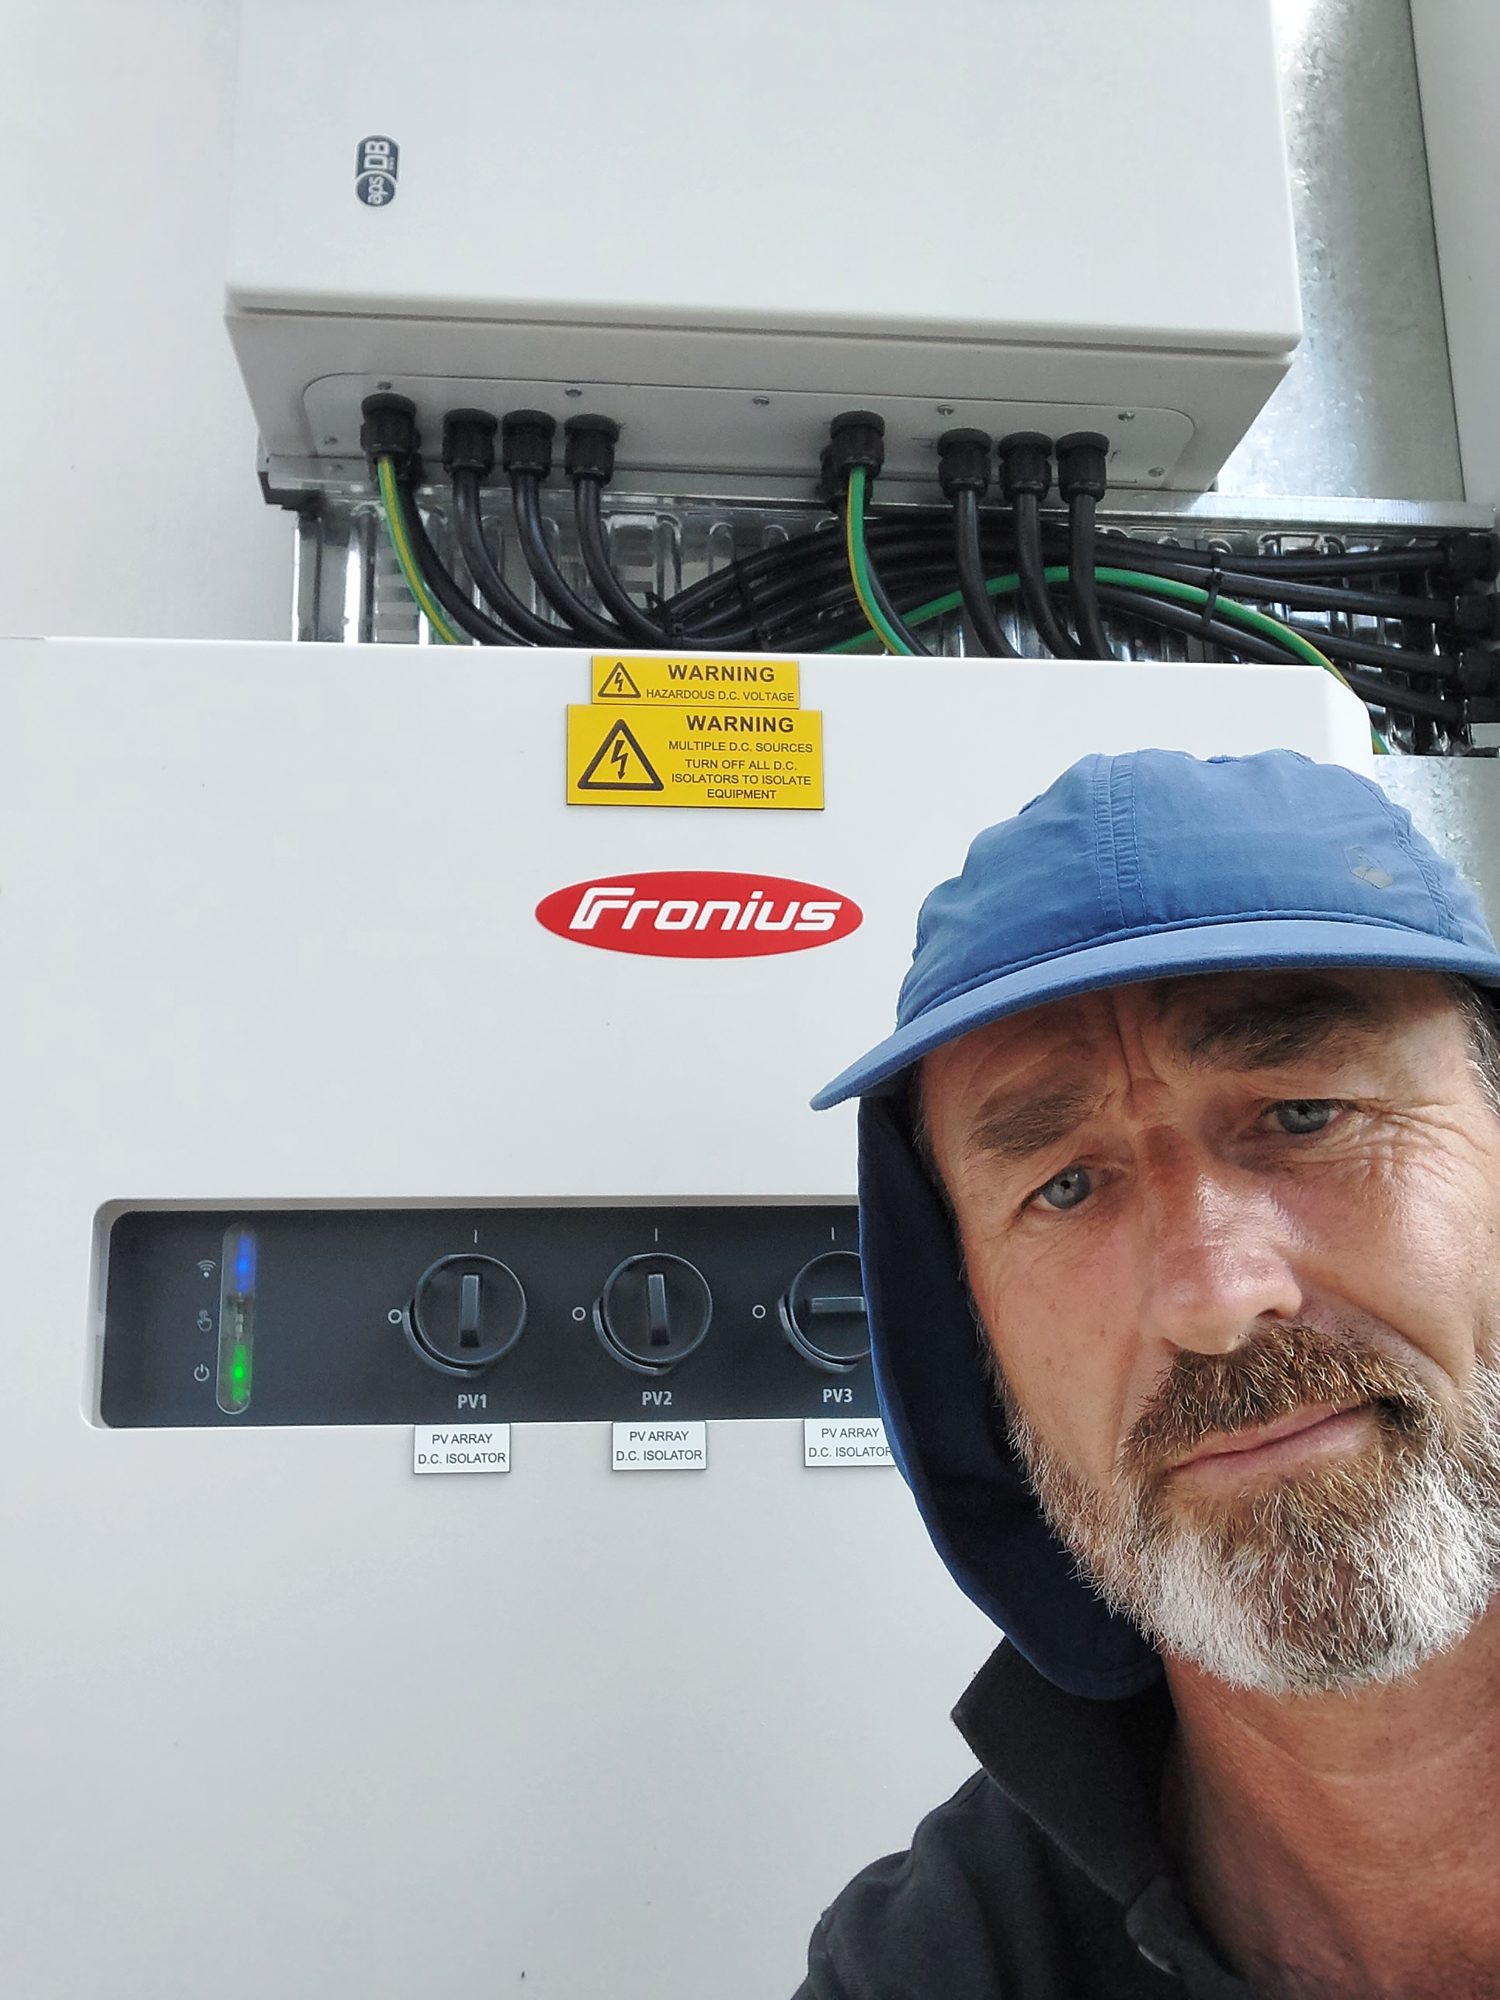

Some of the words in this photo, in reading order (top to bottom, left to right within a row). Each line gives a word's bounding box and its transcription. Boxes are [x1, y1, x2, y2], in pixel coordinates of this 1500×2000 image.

[364, 140, 390, 170] DB
[367, 176, 389, 205] aps
[667, 664, 775, 683] WARNING
[646, 689, 715, 700] HAZARDOUS
[718, 690, 740, 701] D.C.
[743, 691, 795, 702] VOLTAGE
[686, 715, 794, 733] WARNING
[668, 740, 726, 752] MULTIPLE
[729, 741, 753, 752] D.C.
[756, 742, 813, 753] SOURCES
[685, 759, 718, 769] TURN
[722, 759, 745, 769] OFF
[748, 760, 770, 770] ALL
[774, 761, 797, 771] D.C.
[671, 773, 739, 784] ISOLATORS
[742, 774, 759, 784] TO
[762, 775, 811, 786] ISOLATE
[707, 789, 777, 800] EQUIPMENT
[569, 887, 842, 931] Fronius
[457, 1394, 487, 1409] PV1
[642, 1391, 672, 1406] PV2
[823, 1388, 853, 1403] PV3
[432, 1434, 449, 1445] PV
[451, 1433, 493, 1444] ARRAY
[629, 1431, 647, 1442] PV
[648, 1430, 689, 1441] ARRAY
[821, 1428, 838, 1439] PV
[840, 1427, 880, 1438] ARRAY
[418, 1454, 442, 1465] D.C.
[447, 1452, 506, 1464] ISOLATOR
[616, 1451, 640, 1461] D.C.
[643, 1450, 703, 1461] ISOLATOR
[808, 1447, 832, 1458] D.C.
